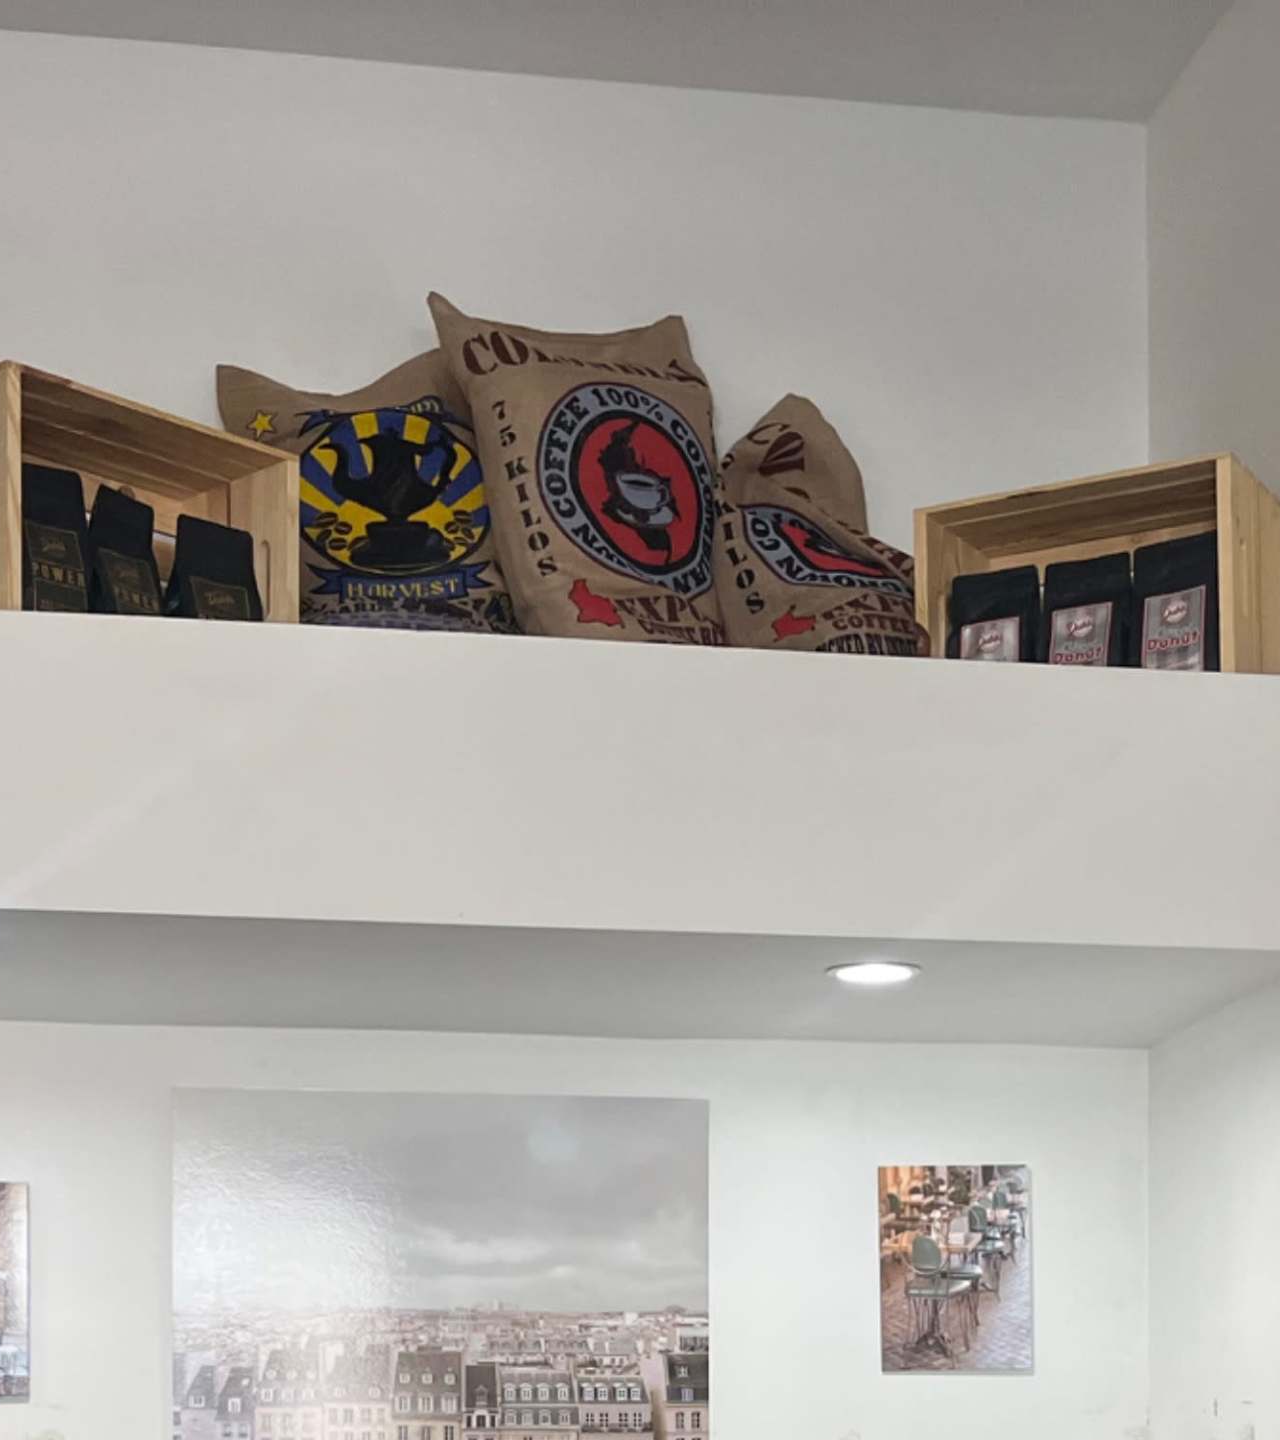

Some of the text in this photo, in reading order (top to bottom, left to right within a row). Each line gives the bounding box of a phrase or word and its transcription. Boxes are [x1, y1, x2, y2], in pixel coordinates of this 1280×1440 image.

[592, 386, 666, 423] 100%
[543, 394, 590, 518] COFFEE
[504, 456, 560, 578] KILOS
[347, 576, 459, 598] HARVEST
